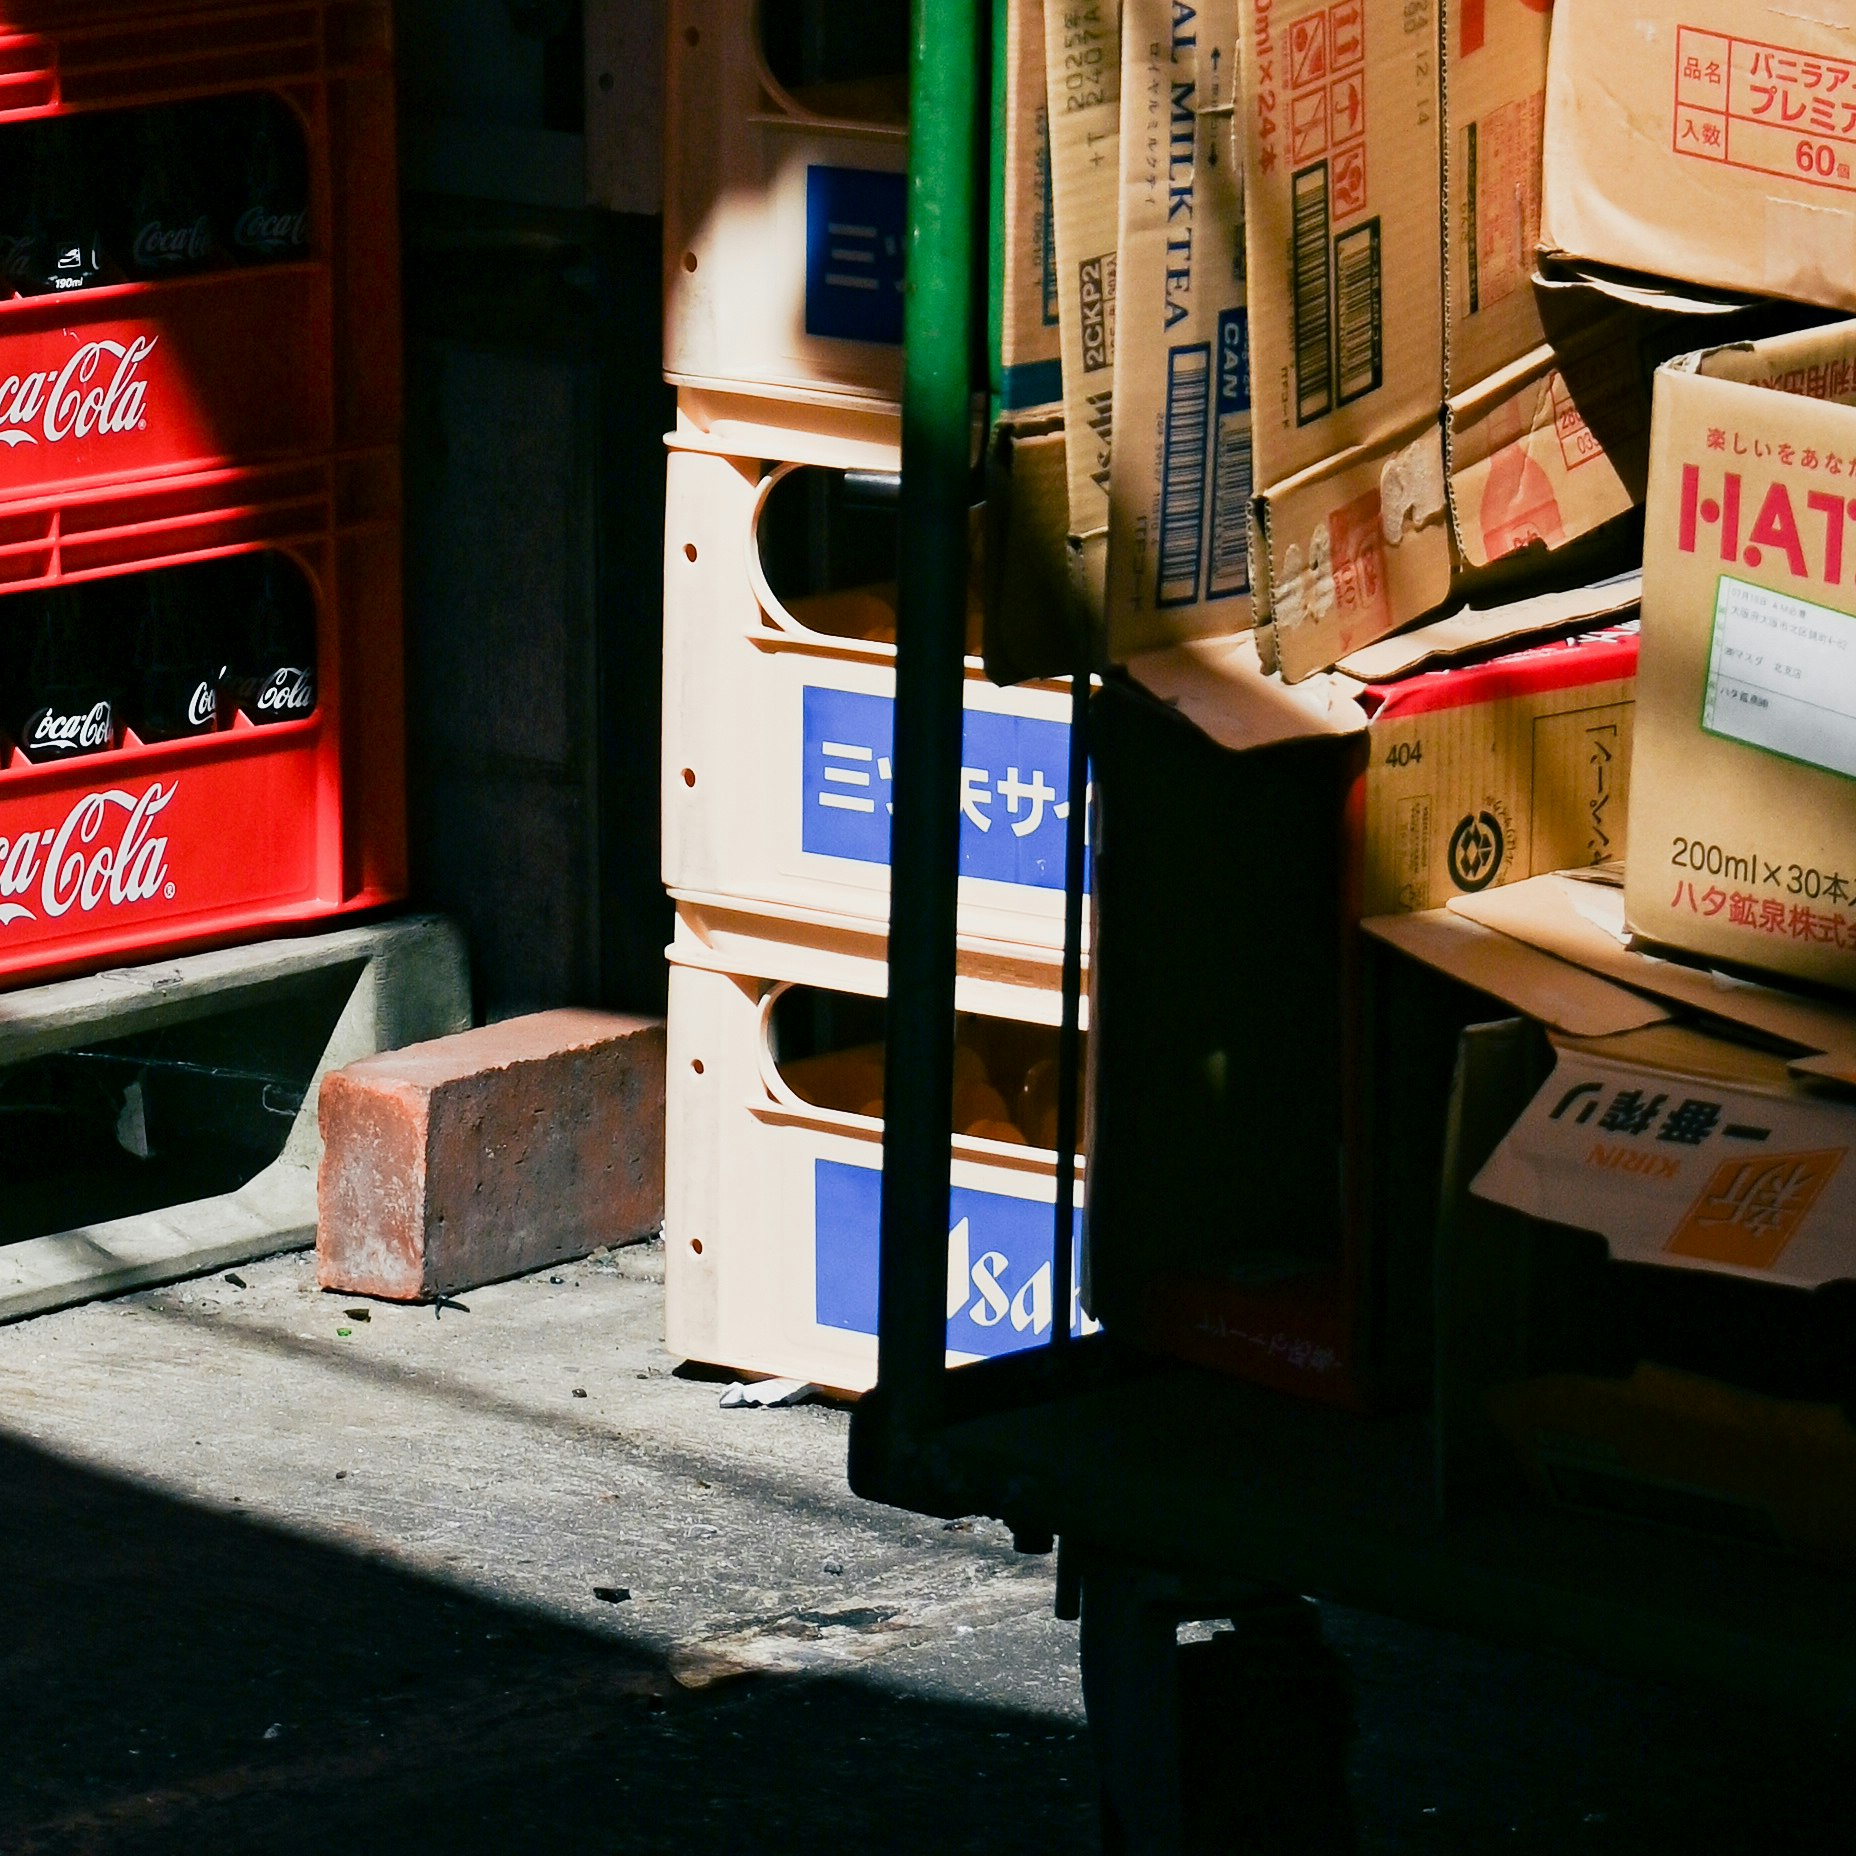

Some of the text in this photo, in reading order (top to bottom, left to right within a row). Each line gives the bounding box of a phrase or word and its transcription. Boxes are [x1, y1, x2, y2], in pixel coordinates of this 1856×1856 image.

[1683, 55, 1722, 85] 品名
[1749, 52, 1856, 93] バニラア
[1167, 81, 1197, 223] MILK
[1680, 118, 1721, 148] 入数
[1163, 226, 1195, 334] TEA
[1081, 260, 1105, 370] 2CKP2
[1222, 320, 1241, 402] CAN
[1385, 740, 1423, 768] 404
[1670, 836, 1856, 908] 200ml×30本
[1549, 1081, 1771, 1145] 一番搾り
[1585, 1144, 1682, 1180] KIRIN
[1697, 1159, 1808, 1239] 新
